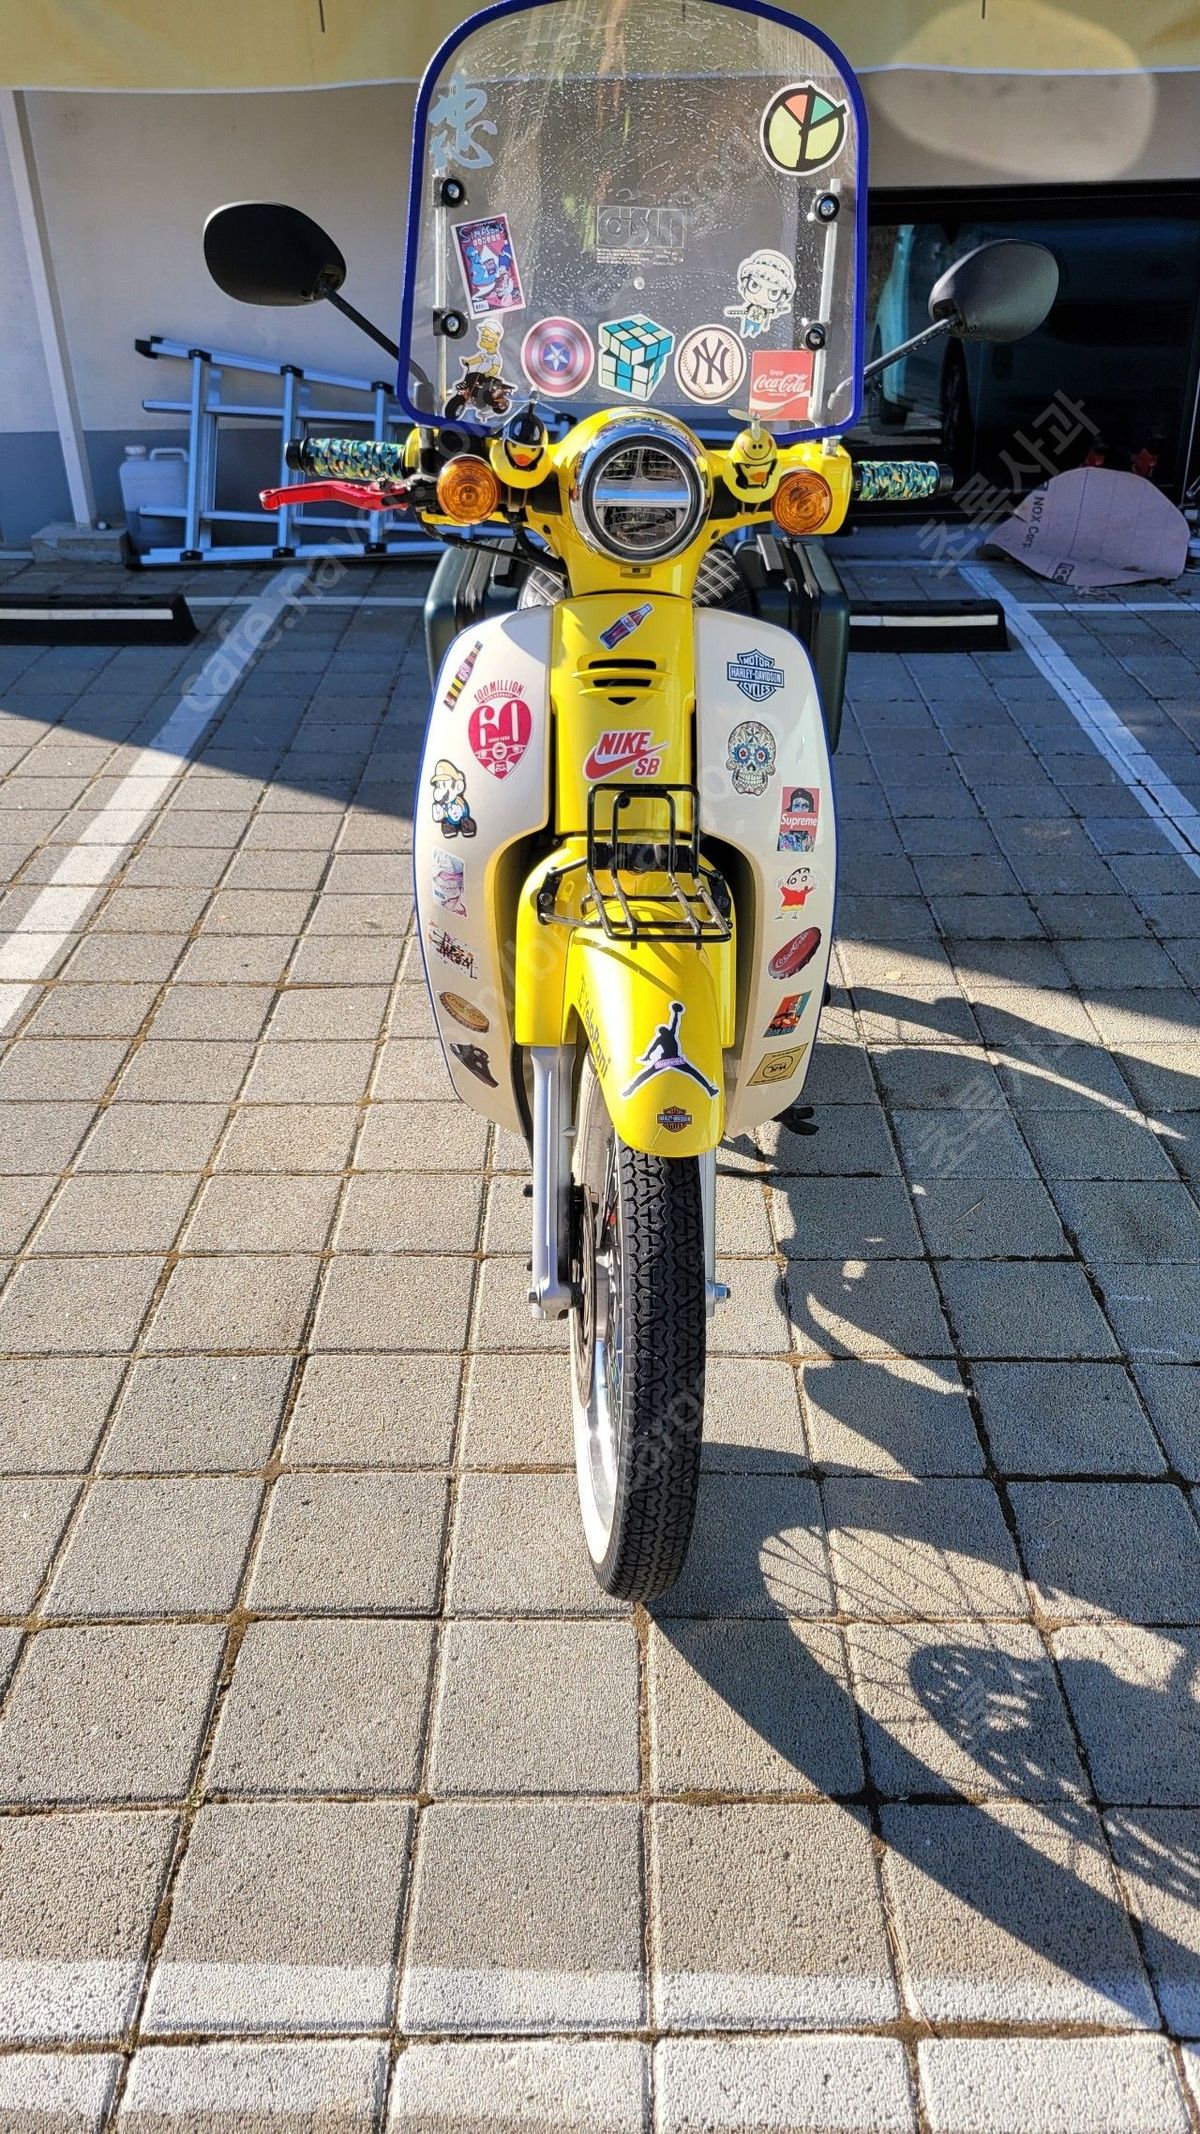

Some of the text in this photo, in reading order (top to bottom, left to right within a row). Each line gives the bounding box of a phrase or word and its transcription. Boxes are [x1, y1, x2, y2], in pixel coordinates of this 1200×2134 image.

[1030, 497, 1045, 524] NOX
[743, 655, 770, 668] MOTOR
[731, 667, 781, 683] HARLEY-DAVIDSON
[489, 679, 525, 697] MILLION
[598, 732, 651, 756] NIKE
[634, 758, 661, 776] SB
[780, 813, 818, 829] Supreme
